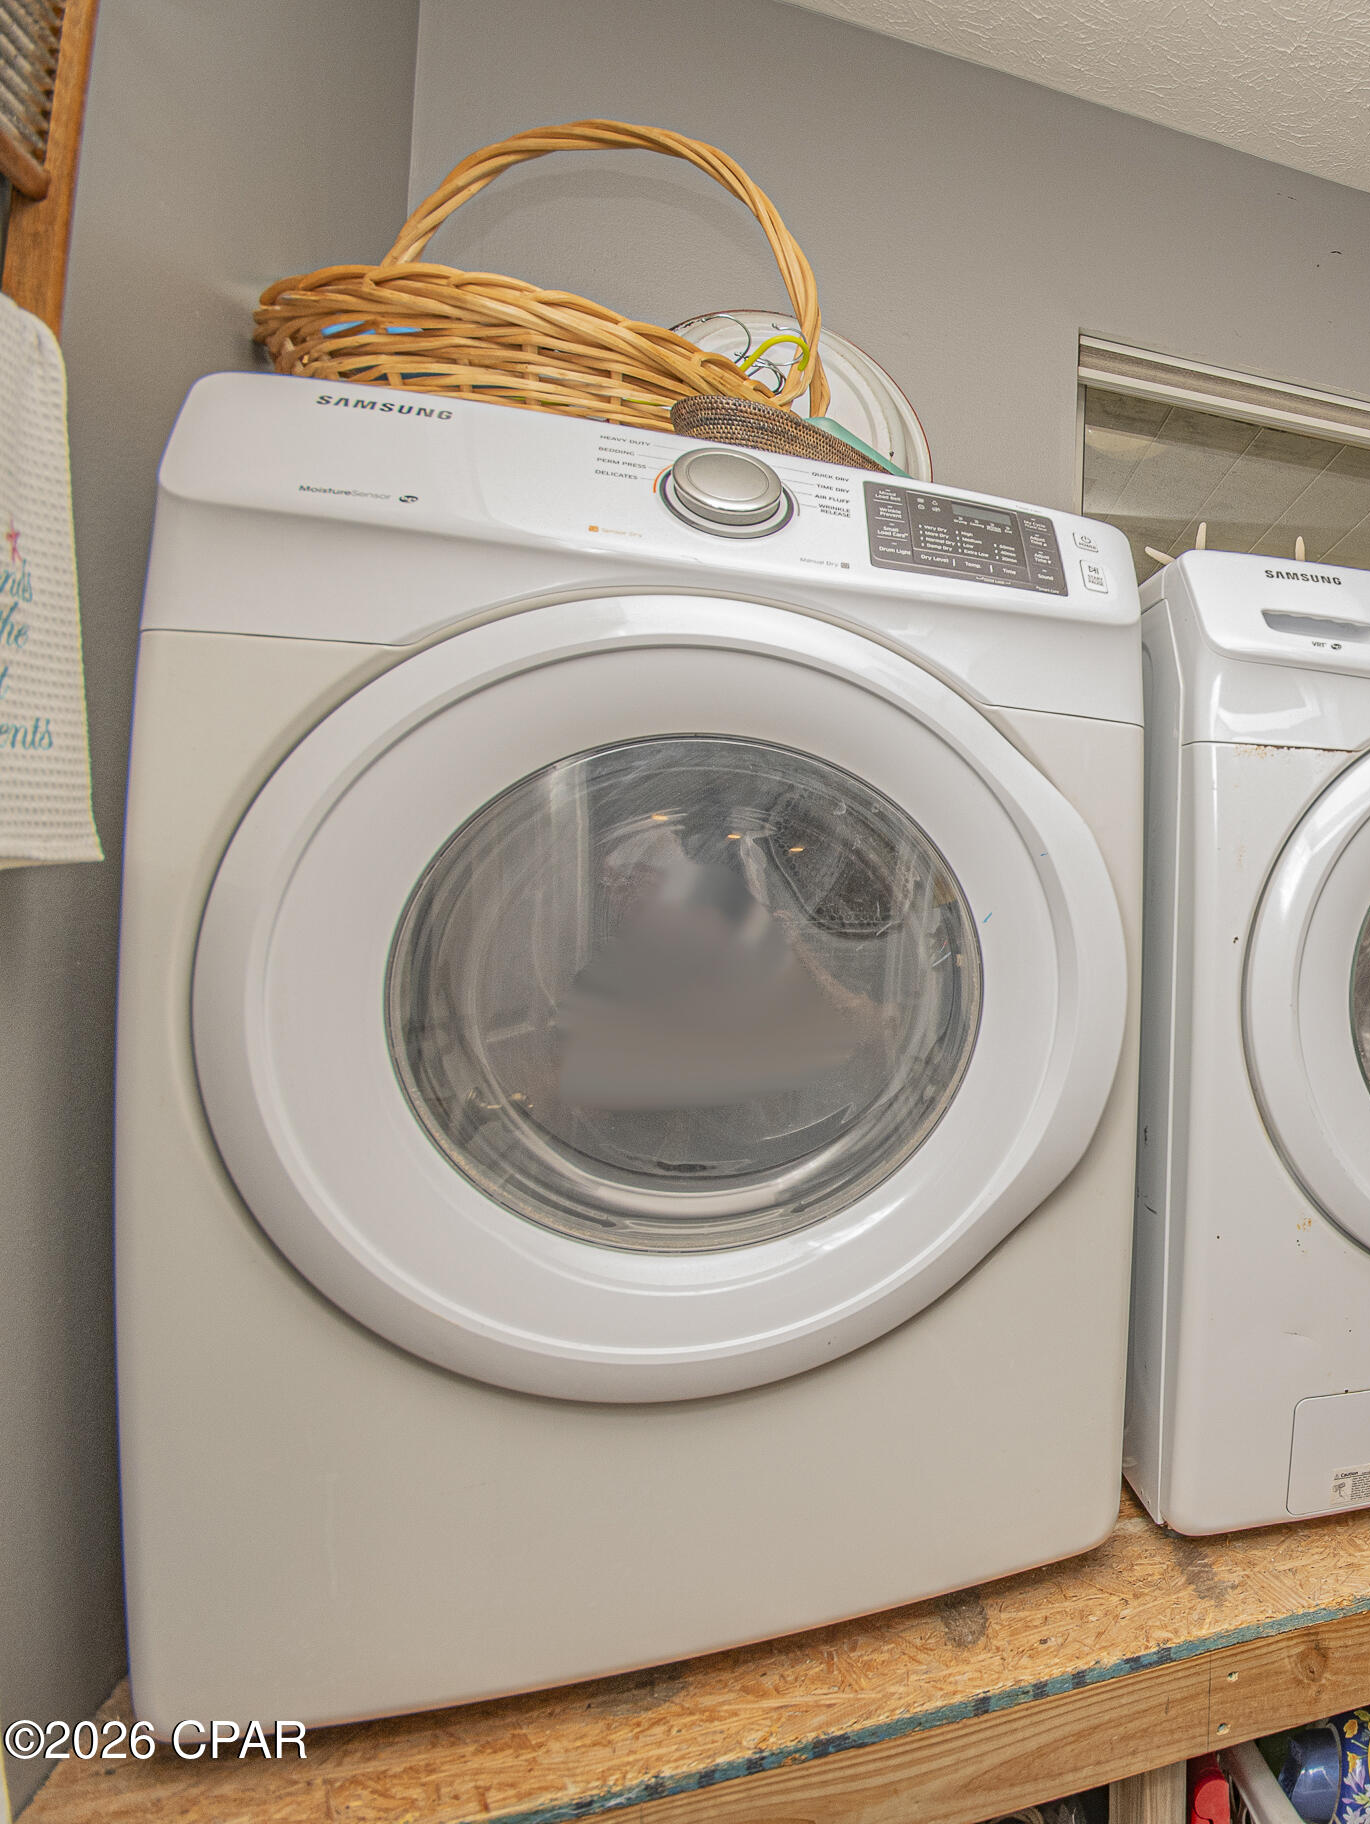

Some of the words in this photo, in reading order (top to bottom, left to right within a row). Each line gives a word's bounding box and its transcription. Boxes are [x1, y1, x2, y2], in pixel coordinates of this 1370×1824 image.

[316, 395, 453, 420] SAMSUNG
[600, 434, 627, 444] HEAVY
[629, 438, 651, 447] DUTY
[598, 446, 635, 456] BEDDING
[596, 457, 620, 466] PERM
[622, 461, 647, 470] PRESS
[594, 469, 638, 480] DELICATES
[812, 471, 834, 480] QUICK
[816, 484, 834, 492] TIME
[828, 496, 850, 504] FLUFF
[818, 504, 850, 512] WRINKLE
[820, 509, 851, 518] RELEASE
[1264, 570, 1342, 586] SAMSUNG
